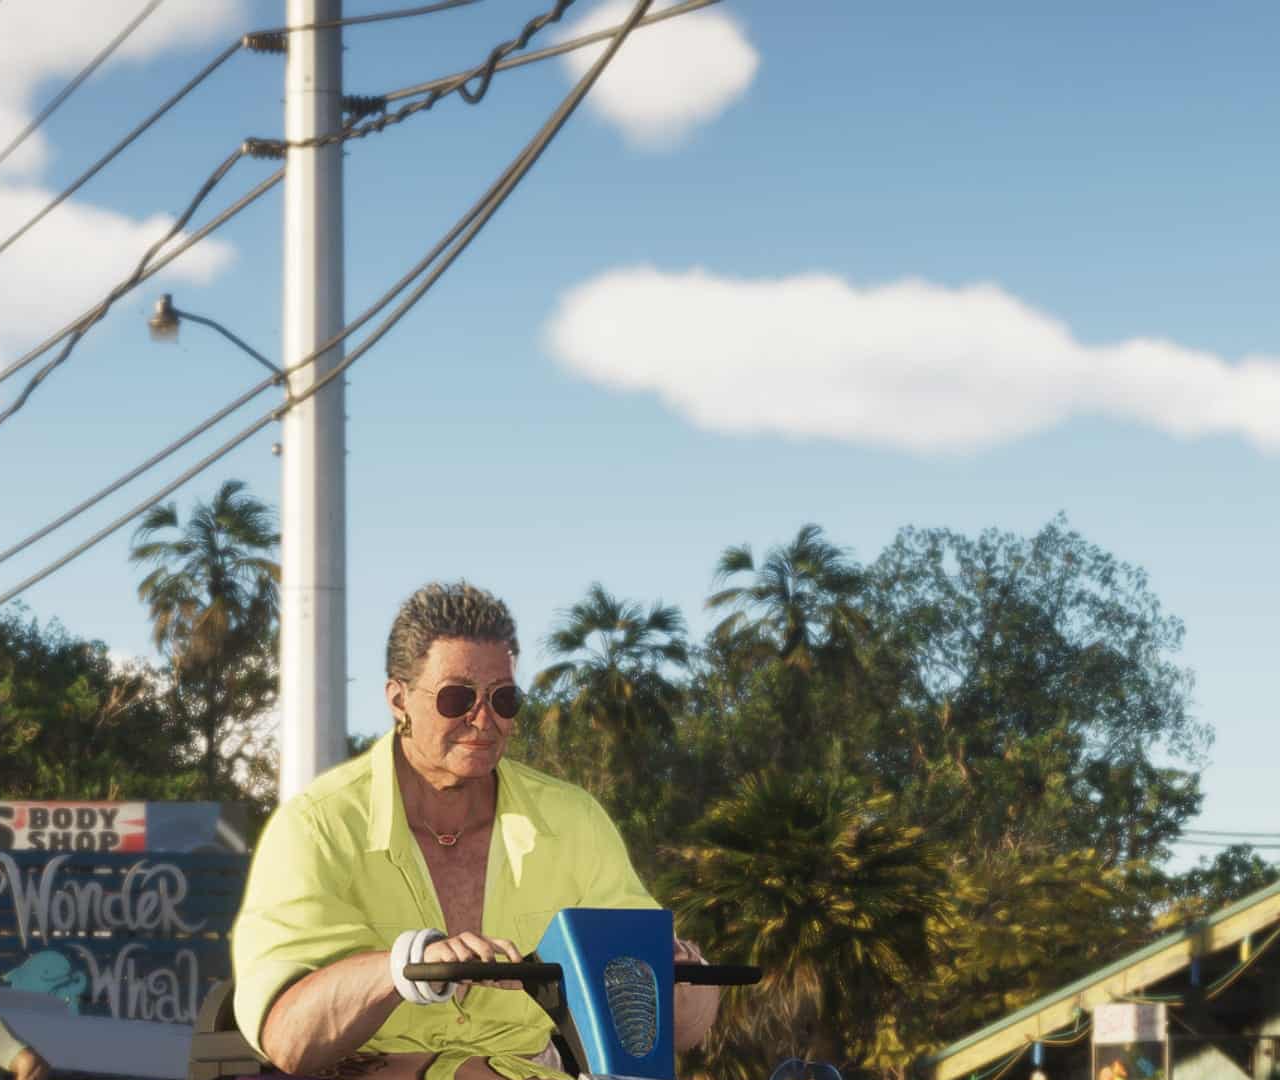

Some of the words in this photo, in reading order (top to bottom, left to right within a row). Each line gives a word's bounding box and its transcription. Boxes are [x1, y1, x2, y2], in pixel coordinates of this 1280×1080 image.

[27, 806, 120, 830] BODY
[27, 831, 123, 852] SHOP
[69, 942, 200, 1023] Whal
